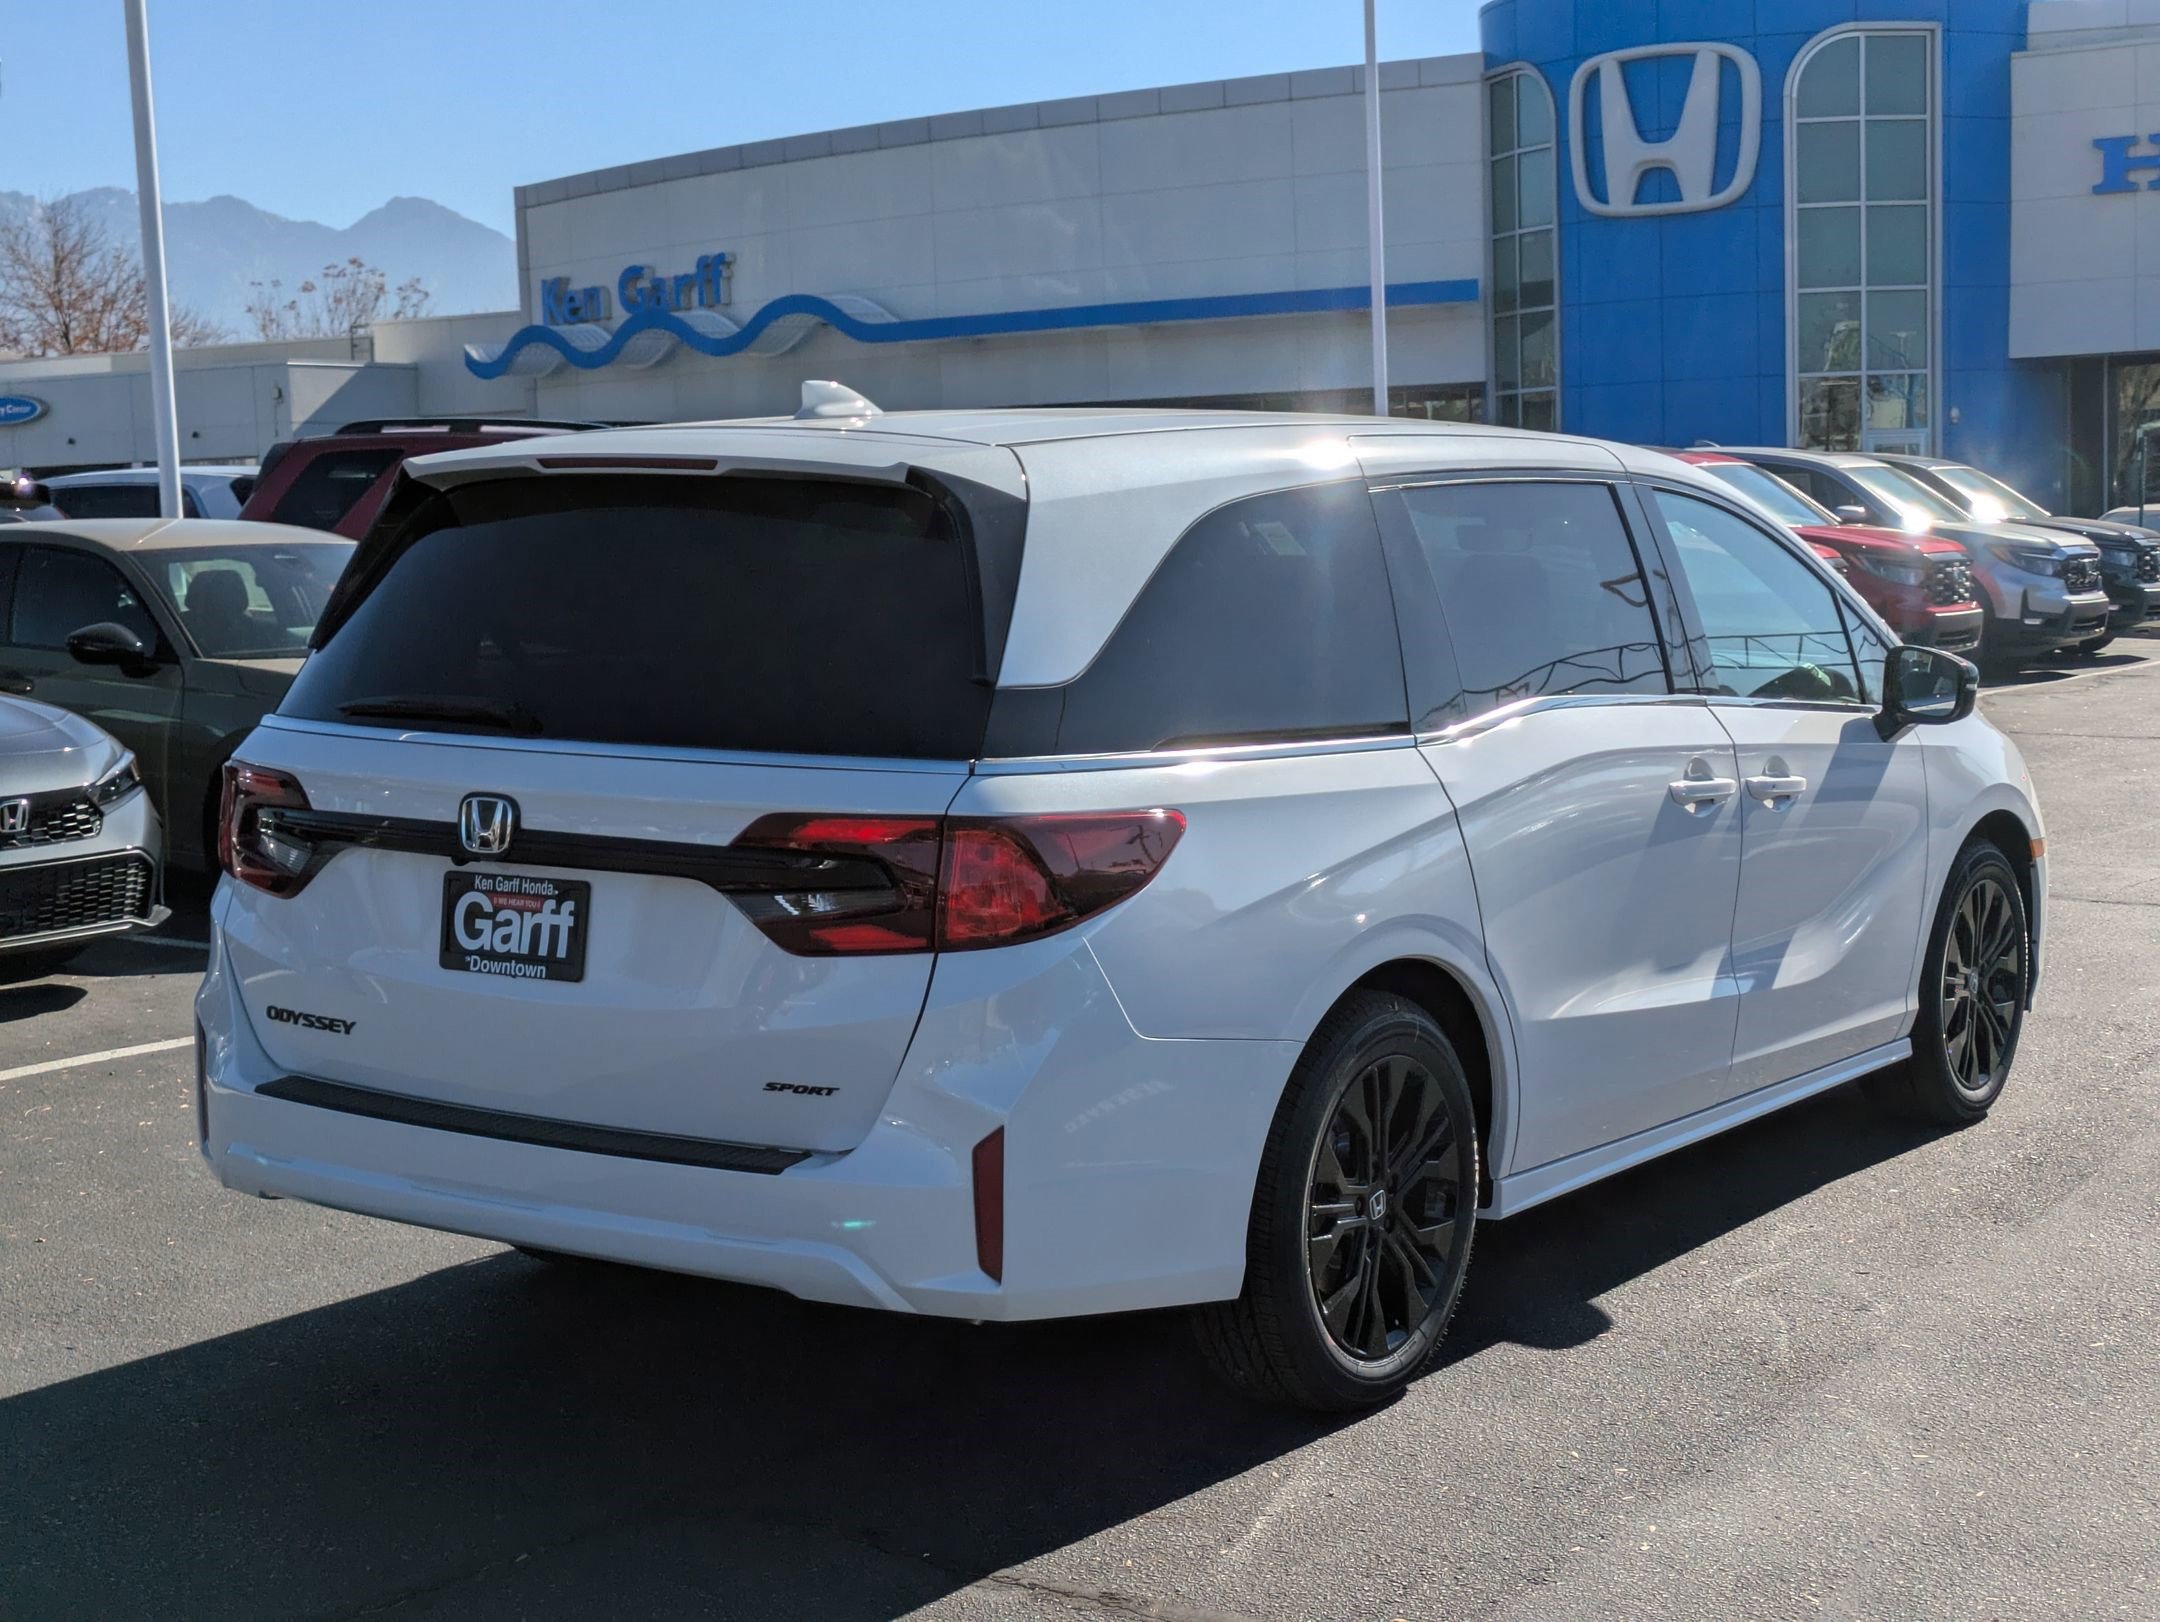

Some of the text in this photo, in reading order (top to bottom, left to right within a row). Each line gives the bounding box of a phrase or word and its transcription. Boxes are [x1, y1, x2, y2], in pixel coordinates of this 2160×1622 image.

[541, 252, 736, 325] Ken Garff
[475, 875, 554, 895] Ken Garff Honda
[454, 891, 575, 958] Garff
[469, 955, 546, 978] Downtown
[266, 1005, 356, 1035] ODYSSEY
[762, 1082, 840, 1096] SPORT
